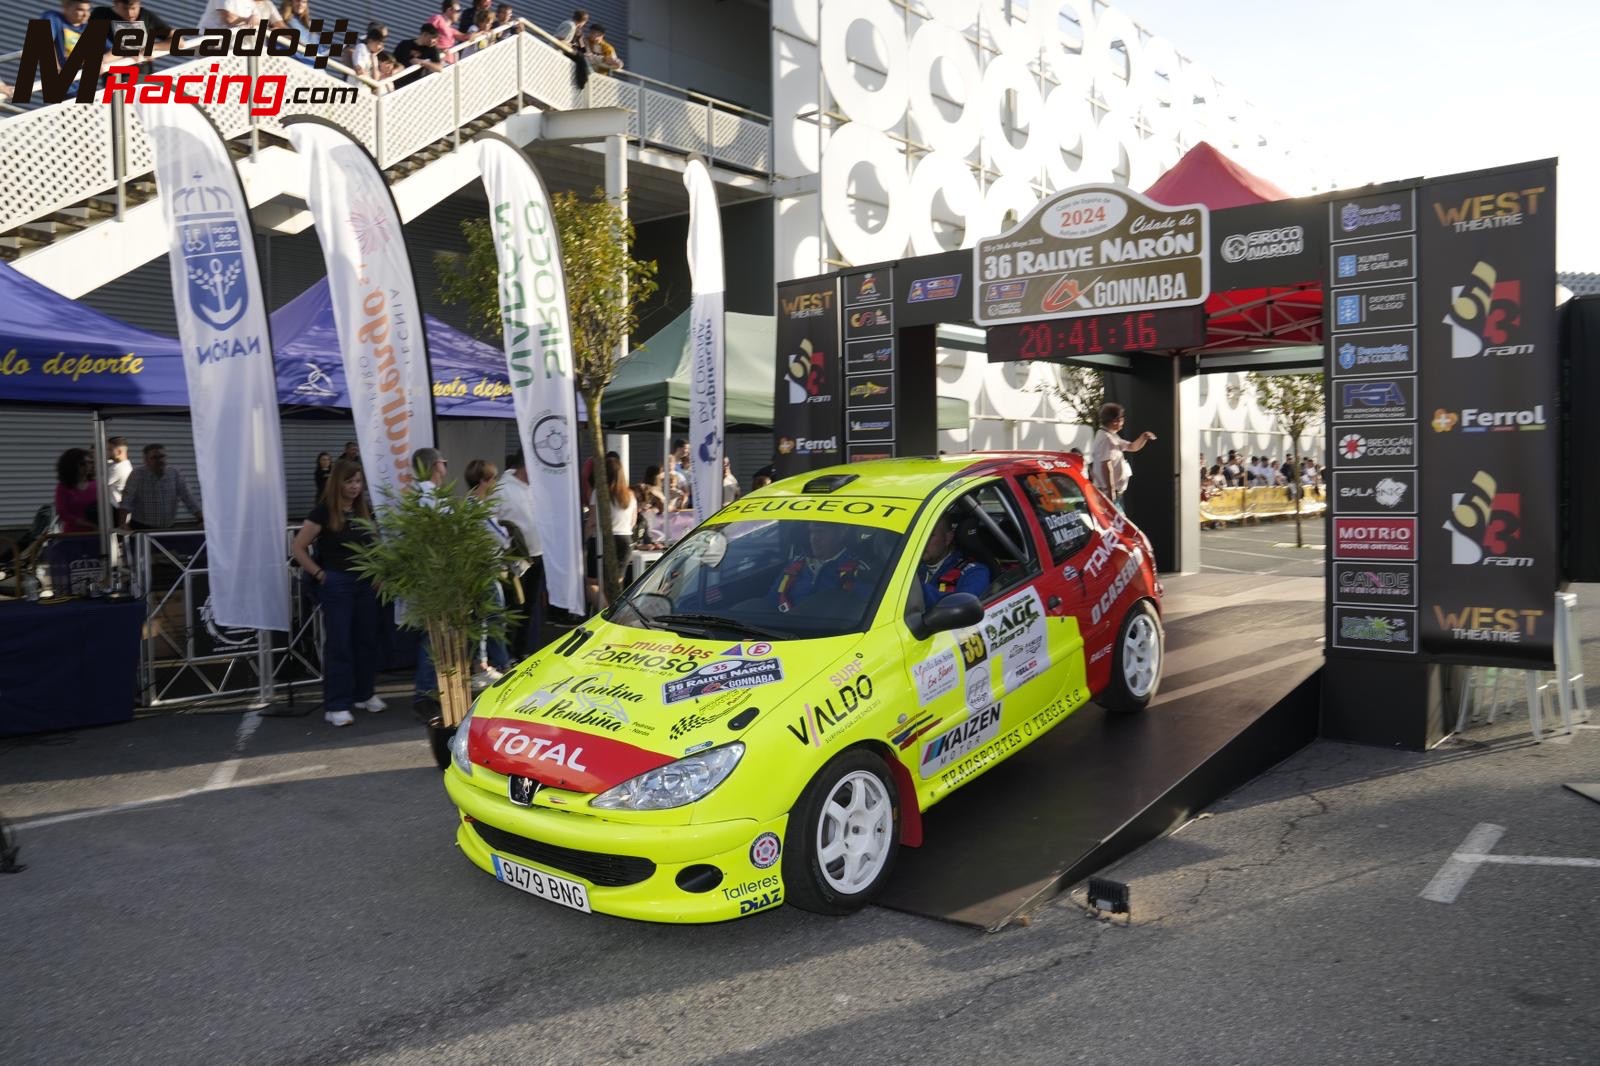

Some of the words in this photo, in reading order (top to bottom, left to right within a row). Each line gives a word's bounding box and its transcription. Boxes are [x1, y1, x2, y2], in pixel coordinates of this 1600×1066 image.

[1061, 206, 1106, 227] 2024
[1433, 186, 1546, 226] WEST
[1130, 214, 1176, 235] Cidade
[1178, 214, 1195, 227] de
[1453, 212, 1523, 233] THEATRE
[1248, 226, 1302, 247] SIROCO
[984, 254, 1012, 280] 36
[1016, 245, 1093, 275] RALLYE
[1101, 230, 1195, 264] NARÓN
[1094, 272, 1188, 307] GONNABA
[1369, 292, 1407, 304] DEPORTE
[782, 290, 833, 317] WEST
[1369, 301, 1404, 312] GALEGO
[1020, 313, 1158, 359] 20:41:16
[0, 348, 31, 375] lo
[42, 351, 144, 382] deporte
[1461, 405, 1546, 427] Ferrol
[796, 435, 837, 450] Ferrol
[1340, 488, 1374, 497] SALA
[716, 499, 906, 519] PEUGEOT
[1340, 570, 1410, 589] CANDE
[998, 598, 1035, 636] AGC
[1433, 605, 1544, 637] WEST
[1452, 628, 1521, 643] THEATRE
[582, 650, 698, 673] FORMOSO
[630, 641, 714, 660] muebles
[686, 674, 727, 688] RALLYE
[730, 663, 776, 678] NARÓN
[728, 673, 775, 688] GONNABA
[830, 659, 863, 687] SURF
[569, 676, 645, 703] Cantina
[514, 699, 537, 715] da
[938, 702, 1001, 753] KAIZEN
[493, 726, 587, 772] TOTAL
[941, 728, 1022, 789] TRANSPORTES
[1023, 722, 1033, 737] O
[503, 862, 544, 895] 9479
[547, 877, 584, 908] BNG
[722, 875, 779, 901] Talleres
